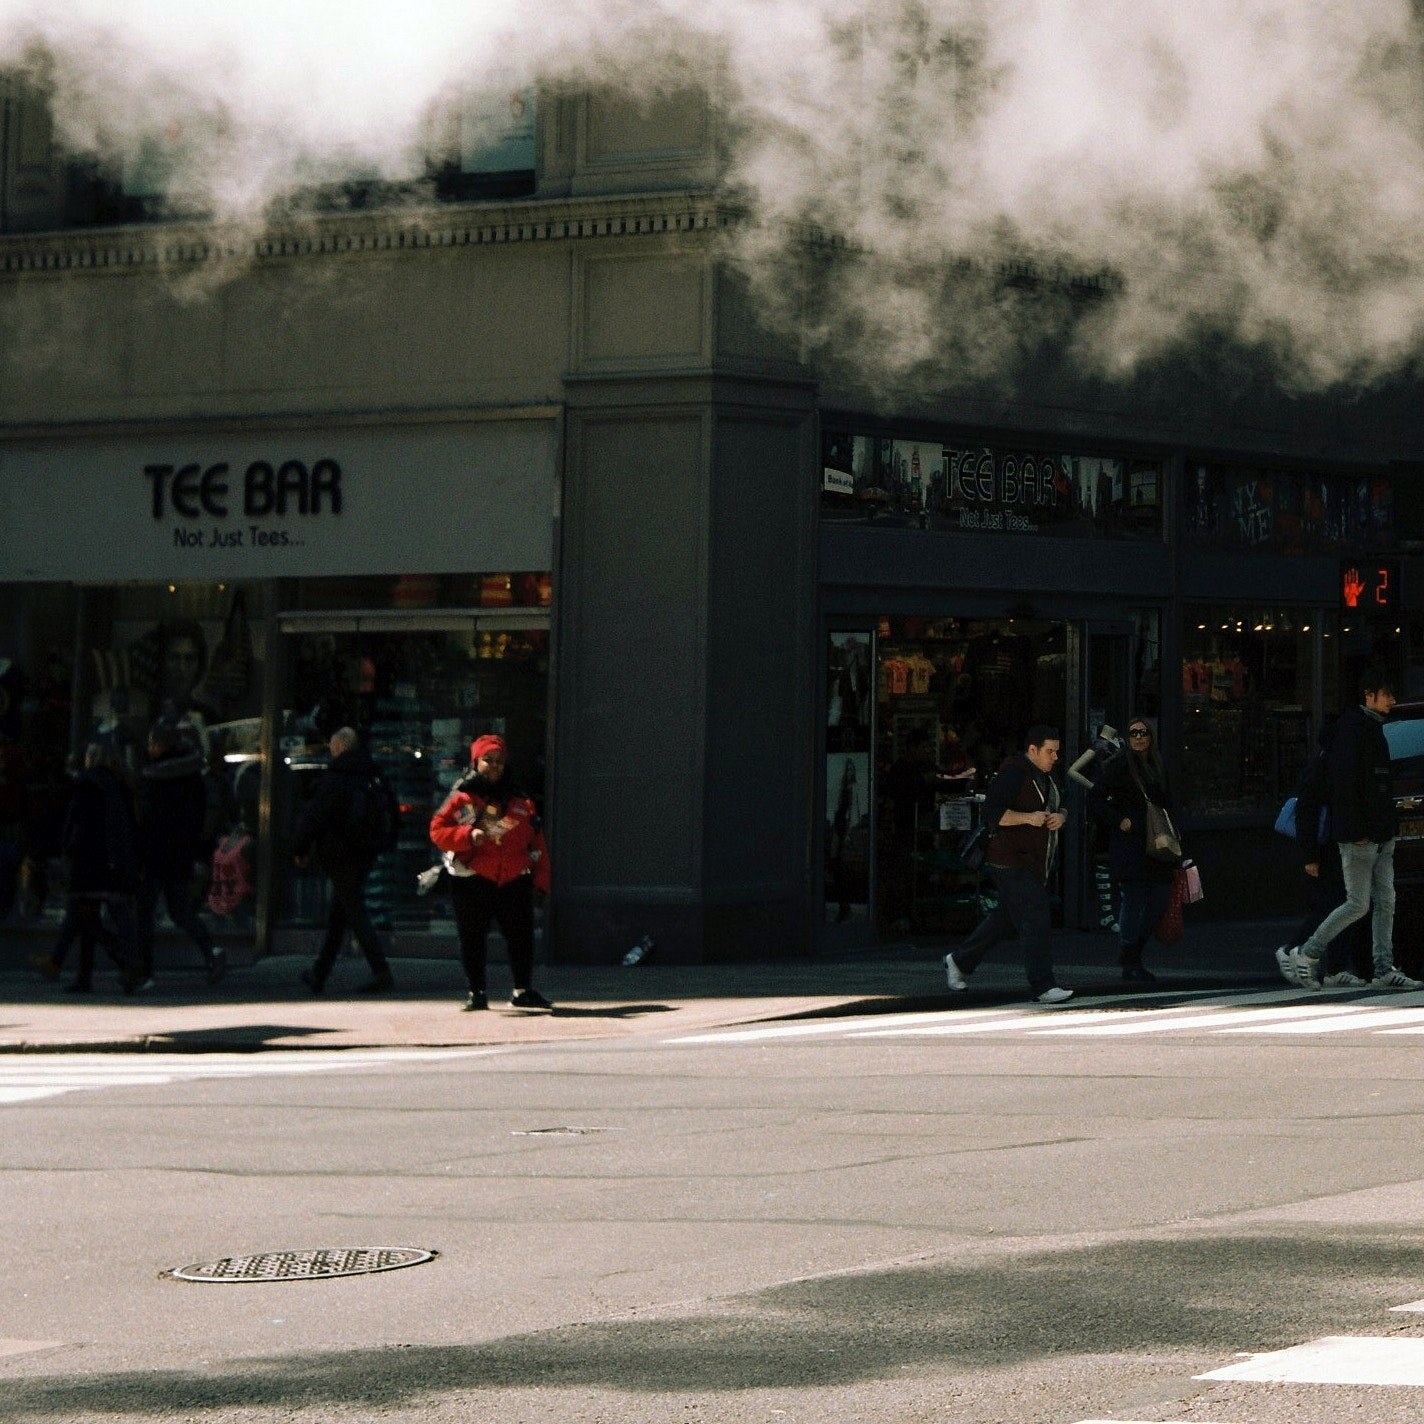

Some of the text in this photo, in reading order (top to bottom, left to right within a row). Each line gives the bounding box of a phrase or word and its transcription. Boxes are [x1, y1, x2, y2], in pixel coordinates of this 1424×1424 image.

[144, 459, 342, 519] TEE BAR
[942, 449, 1058, 507] TEE BAR
[959, 506, 981, 528] Not
[981, 508, 1004, 530] Just
[174, 526, 305, 548] Not Just Tees...
[1376, 569, 1389, 604] 2
